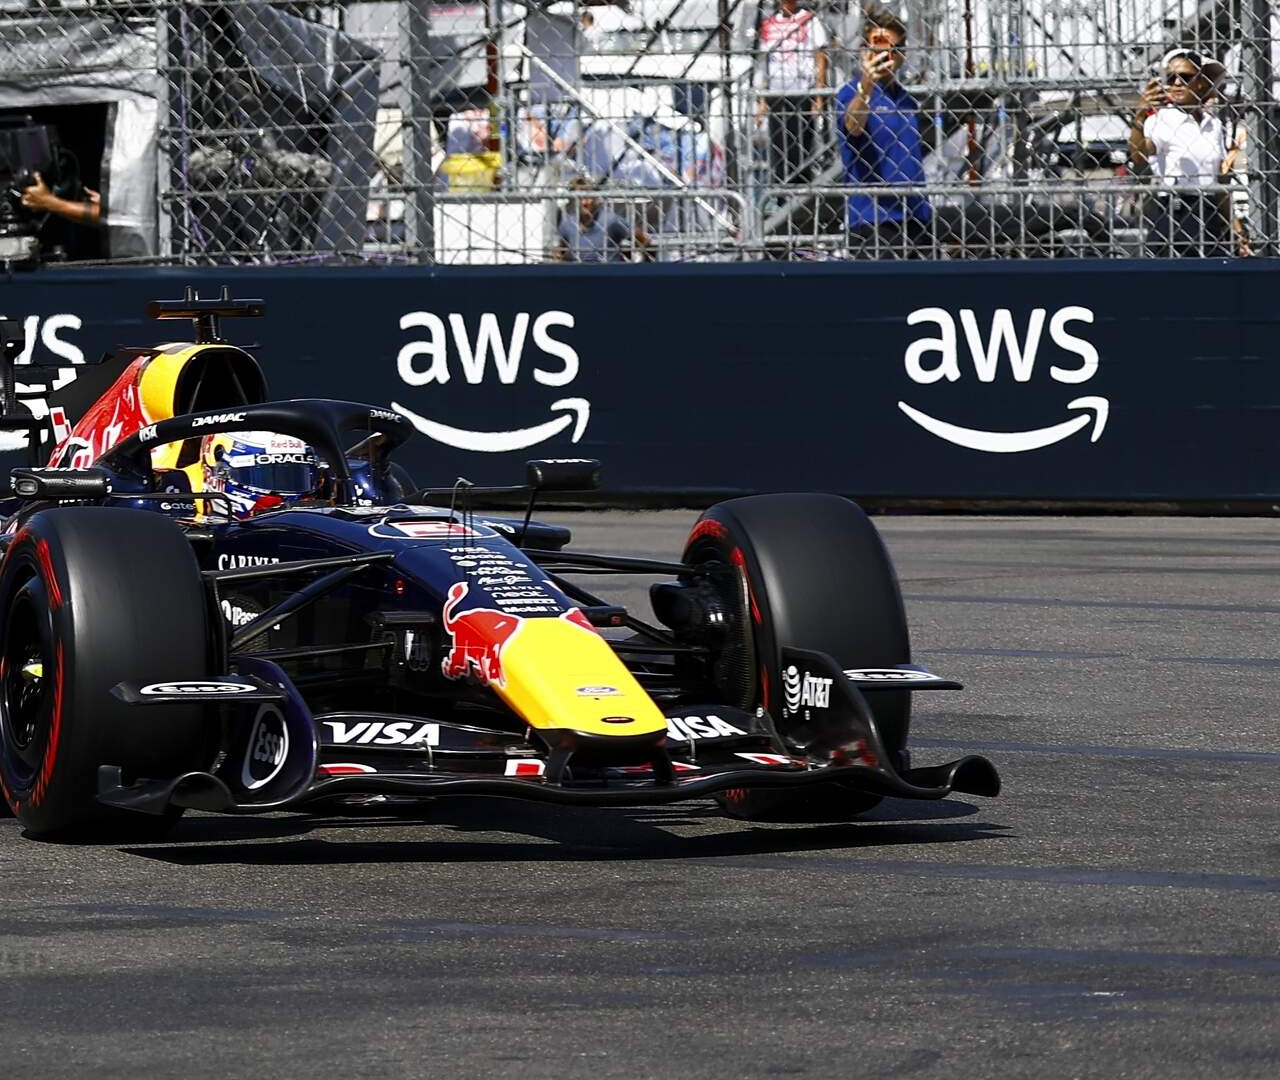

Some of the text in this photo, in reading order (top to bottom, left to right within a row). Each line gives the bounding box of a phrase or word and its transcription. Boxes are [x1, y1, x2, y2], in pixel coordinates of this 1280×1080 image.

[398, 311, 579, 387] aws
[905, 306, 1100, 384] aws
[191, 411, 247, 428] DAMAC
[369, 409, 403, 424] DAMAC
[270, 440, 304, 449] Red Bull
[255, 453, 317, 465] ORACLE
[802, 676, 834, 709] AT&T
[323, 721, 440, 746] VISA
